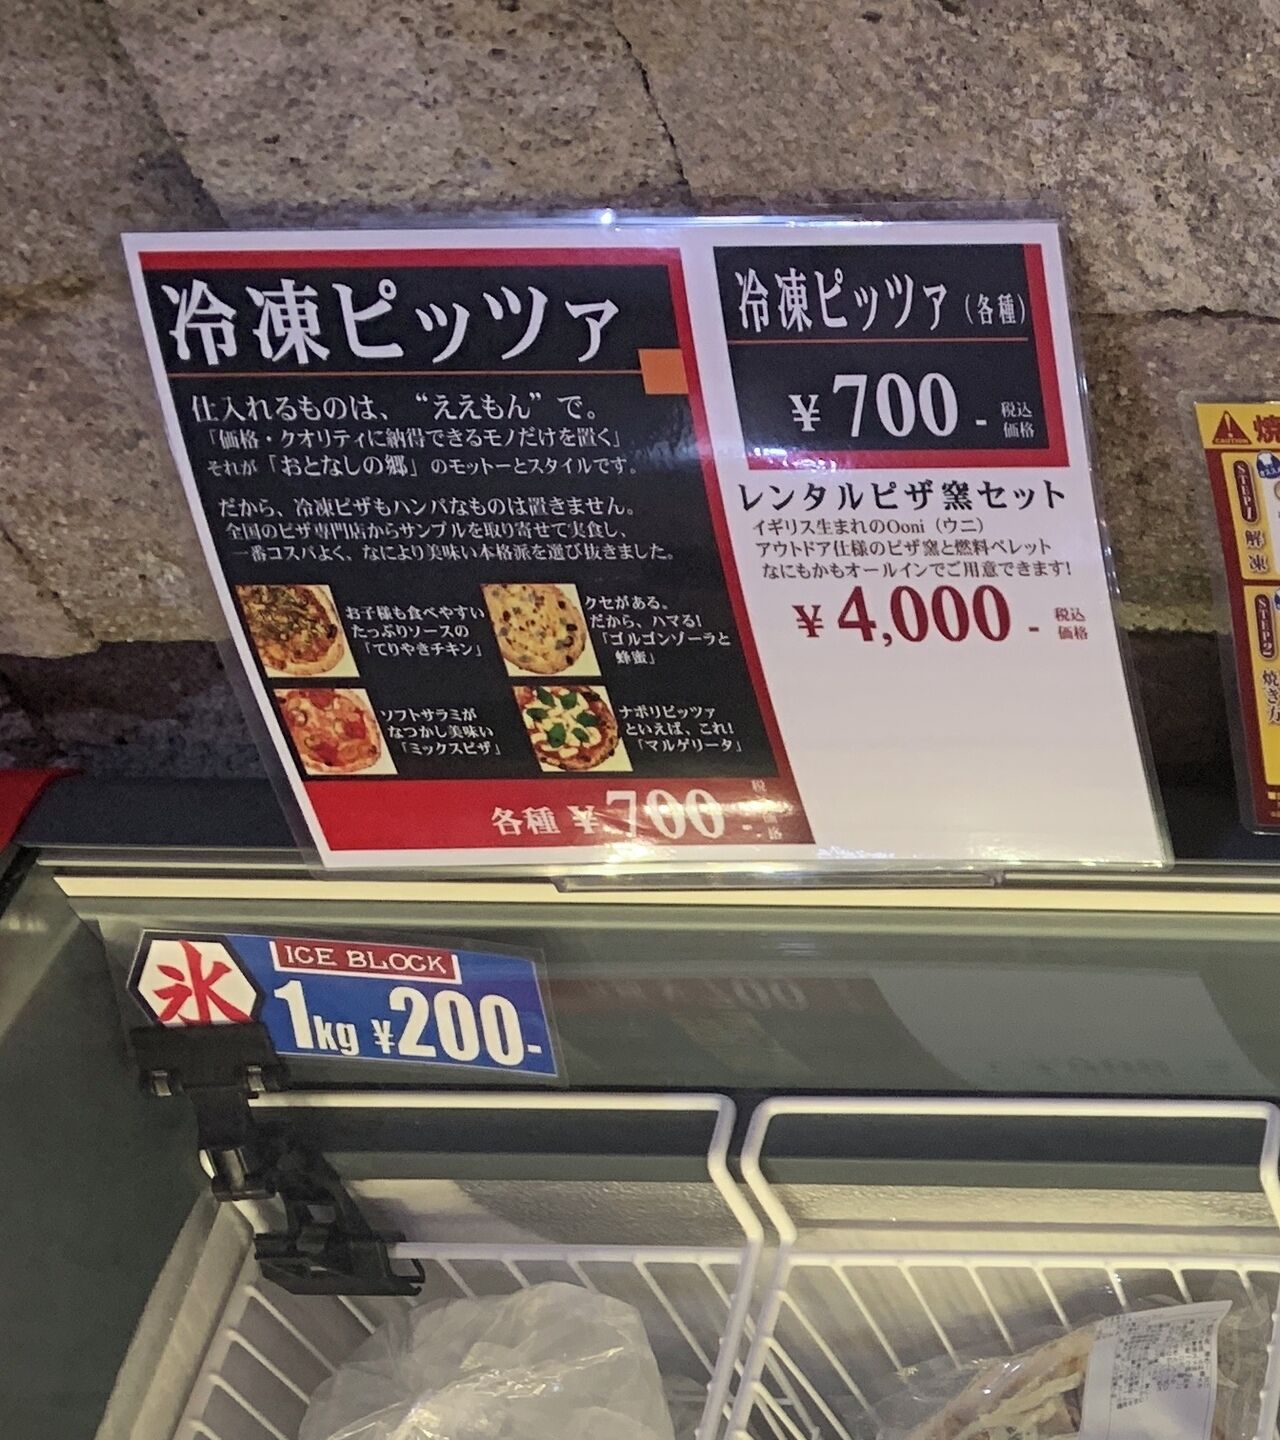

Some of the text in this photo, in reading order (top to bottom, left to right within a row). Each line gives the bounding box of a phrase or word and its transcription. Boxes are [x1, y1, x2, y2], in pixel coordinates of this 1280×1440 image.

[736, 268, 1027, 334] 冷凍ピッツァ (各種)
[162, 279, 619, 365] 冷凍ピッツァ
[1001, 401, 1032, 419] 税込
[1003, 421, 1035, 439] 価格
[737, 480, 1066, 512] レンタルピザ窯セット
[219, 496, 636, 519] だから、冷凍ピザもハンパなものは置きません。
[755, 539, 1052, 559] アウトドア仕様のピザ窯と燃料ペレット
[1245, 530, 1266, 573] 解凍
[763, 559, 1071, 579] なにもかもオールインでご用意できます!
[585, 596, 670, 611] クセがある。
[345, 605, 485, 623] お子様も食べやすい
[1054, 607, 1086, 623] 税込
[351, 623, 469, 640] たっぷりソースの
[602, 630, 731, 648] 「ゴルゴンゾーラと
[1058, 625, 1089, 641] 価格
[365, 641, 484, 660] 「てりやきチキン」
[616, 648, 657, 666] 蜂蜜」
[380, 707, 477, 723] ソフトサラミが
[618, 705, 716, 721] ナポリピッツァ
[387, 724, 495, 740] なつかし美味い
[400, 741, 502, 757] 「ミックスピザ」
[637, 738, 745, 755] 「マルゲリータ」
[491, 807, 560, 837] 各種
[286, 945, 447, 975] ICE BLOCK
[156, 939, 253, 1025] 氷
[274, 980, 359, 1056] 1kg
